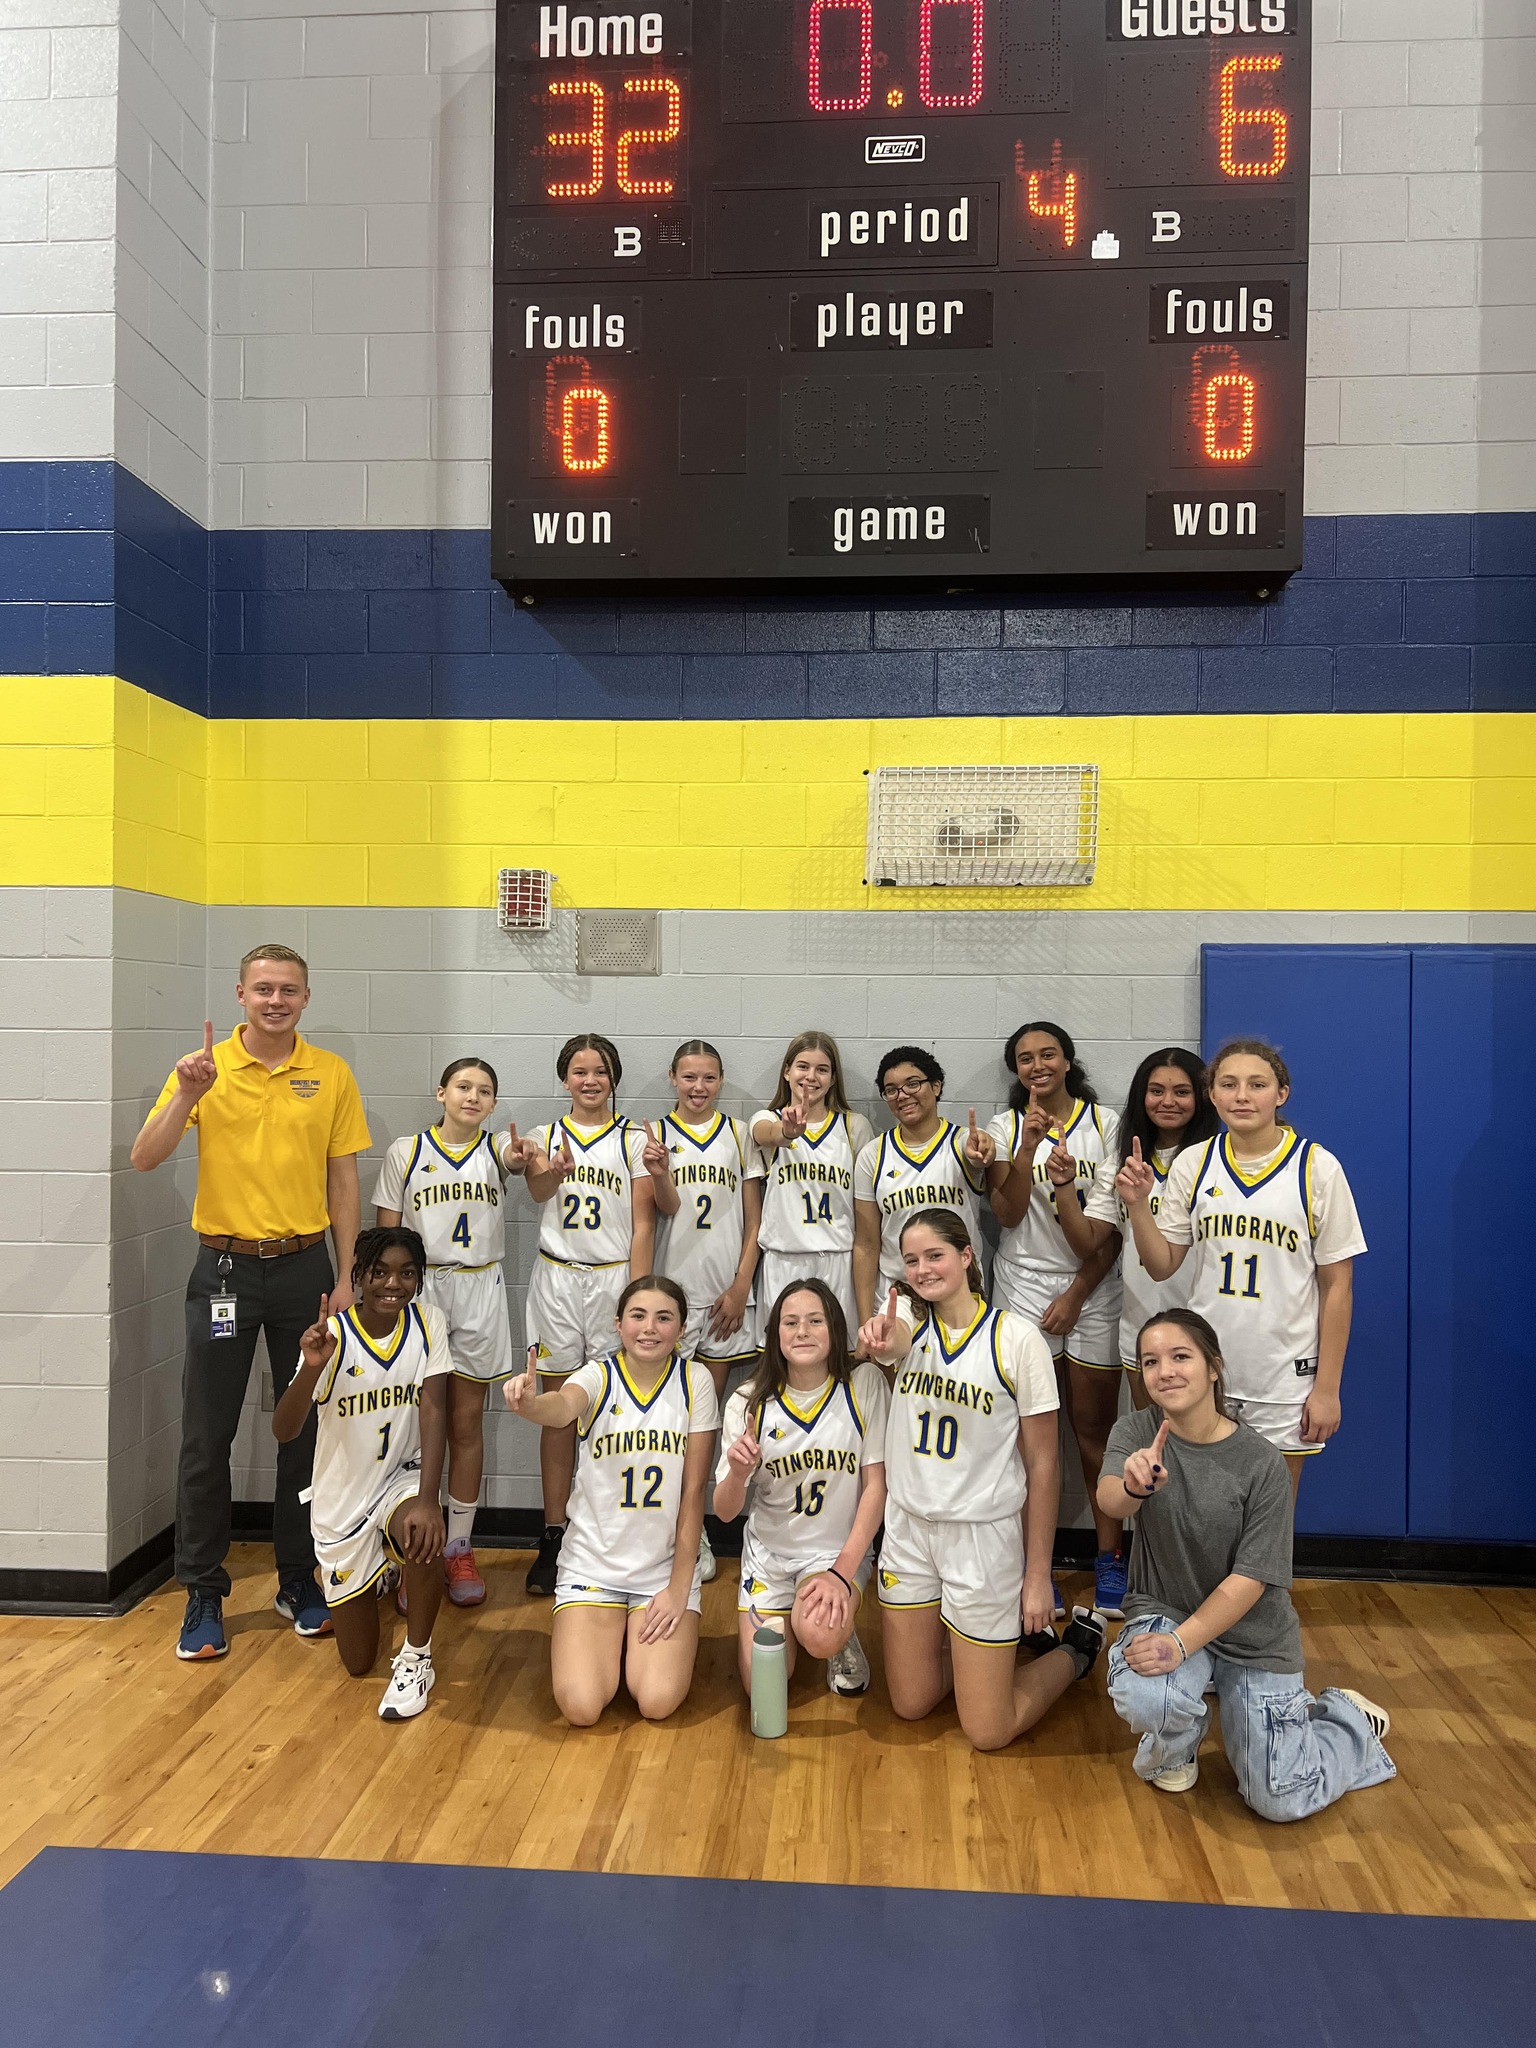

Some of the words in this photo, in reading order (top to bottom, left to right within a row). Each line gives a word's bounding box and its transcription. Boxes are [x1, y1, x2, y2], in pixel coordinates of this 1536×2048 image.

[539, 5, 663, 58] Home
[1121, 0, 1287, 38] Guests
[808, 0, 983, 111] 0.0
[1219, 55, 1287, 176] 6
[547, 78, 680, 198] 32
[820, 197, 969, 258] period
[1028, 173, 1077, 247] 4
[1151, 210, 1182, 243] B
[613, 226, 642, 257] B
[525, 304, 625, 349] fouls
[817, 292, 964, 348] player
[1166, 287, 1273, 334] fouls
[562, 388, 609, 471] 0
[1205, 374, 1254, 461] 0
[532, 510, 611, 544] won
[834, 503, 945, 552] game
[1173, 500, 1257, 535] won
[413, 1182, 498, 1212] STINGRAYS
[674, 1164, 737, 1193] TINGRAYS
[778, 1162, 850, 1191] STINGRAYS
[563, 1193, 602, 1231] 23
[696, 1194, 711, 1230] 2
[802, 1191, 832, 1225] 14
[883, 1185, 964, 1215] STINGRAYS
[452, 1212, 471, 1248] 4
[1219, 1252, 1260, 1298] 11
[900, 1371, 994, 1415] STINGRAYS
[376, 1421, 392, 1461] 1
[914, 1410, 958, 1460] 10
[765, 1448, 857, 1479] STINGRAYS
[620, 1465, 663, 1509] 12
[790, 1480, 827, 1517] 15
